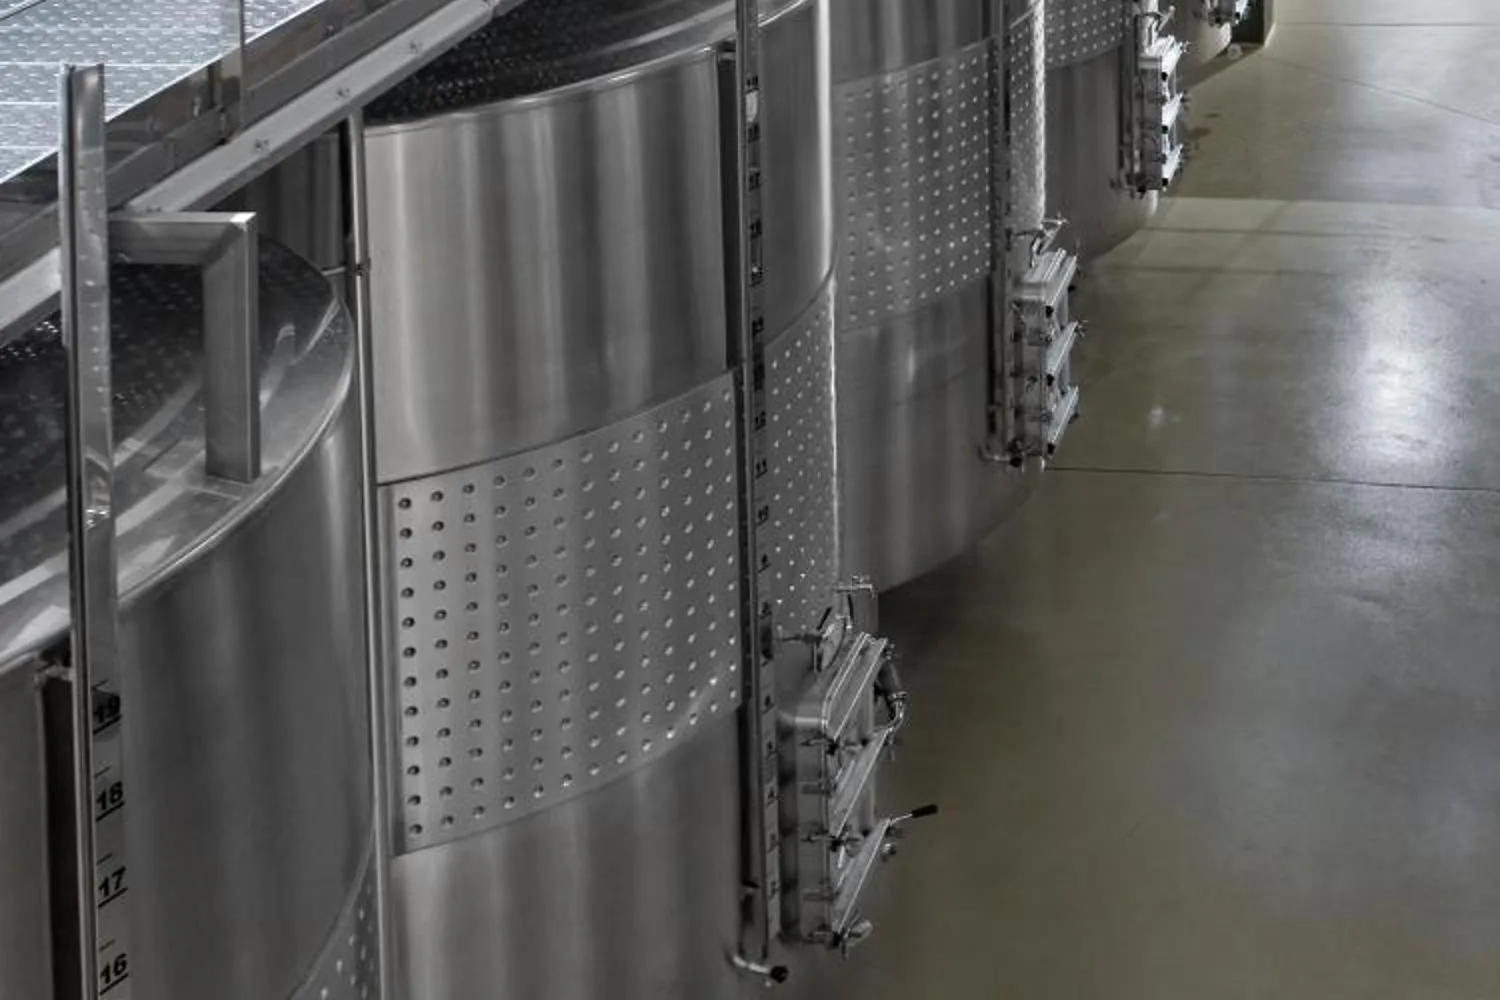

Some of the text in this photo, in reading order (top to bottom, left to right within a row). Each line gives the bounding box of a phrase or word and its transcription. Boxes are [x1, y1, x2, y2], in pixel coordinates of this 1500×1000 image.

[97, 781, 123, 810] 18
[98, 866, 126, 898] 17
[100, 953, 127, 983] 16
